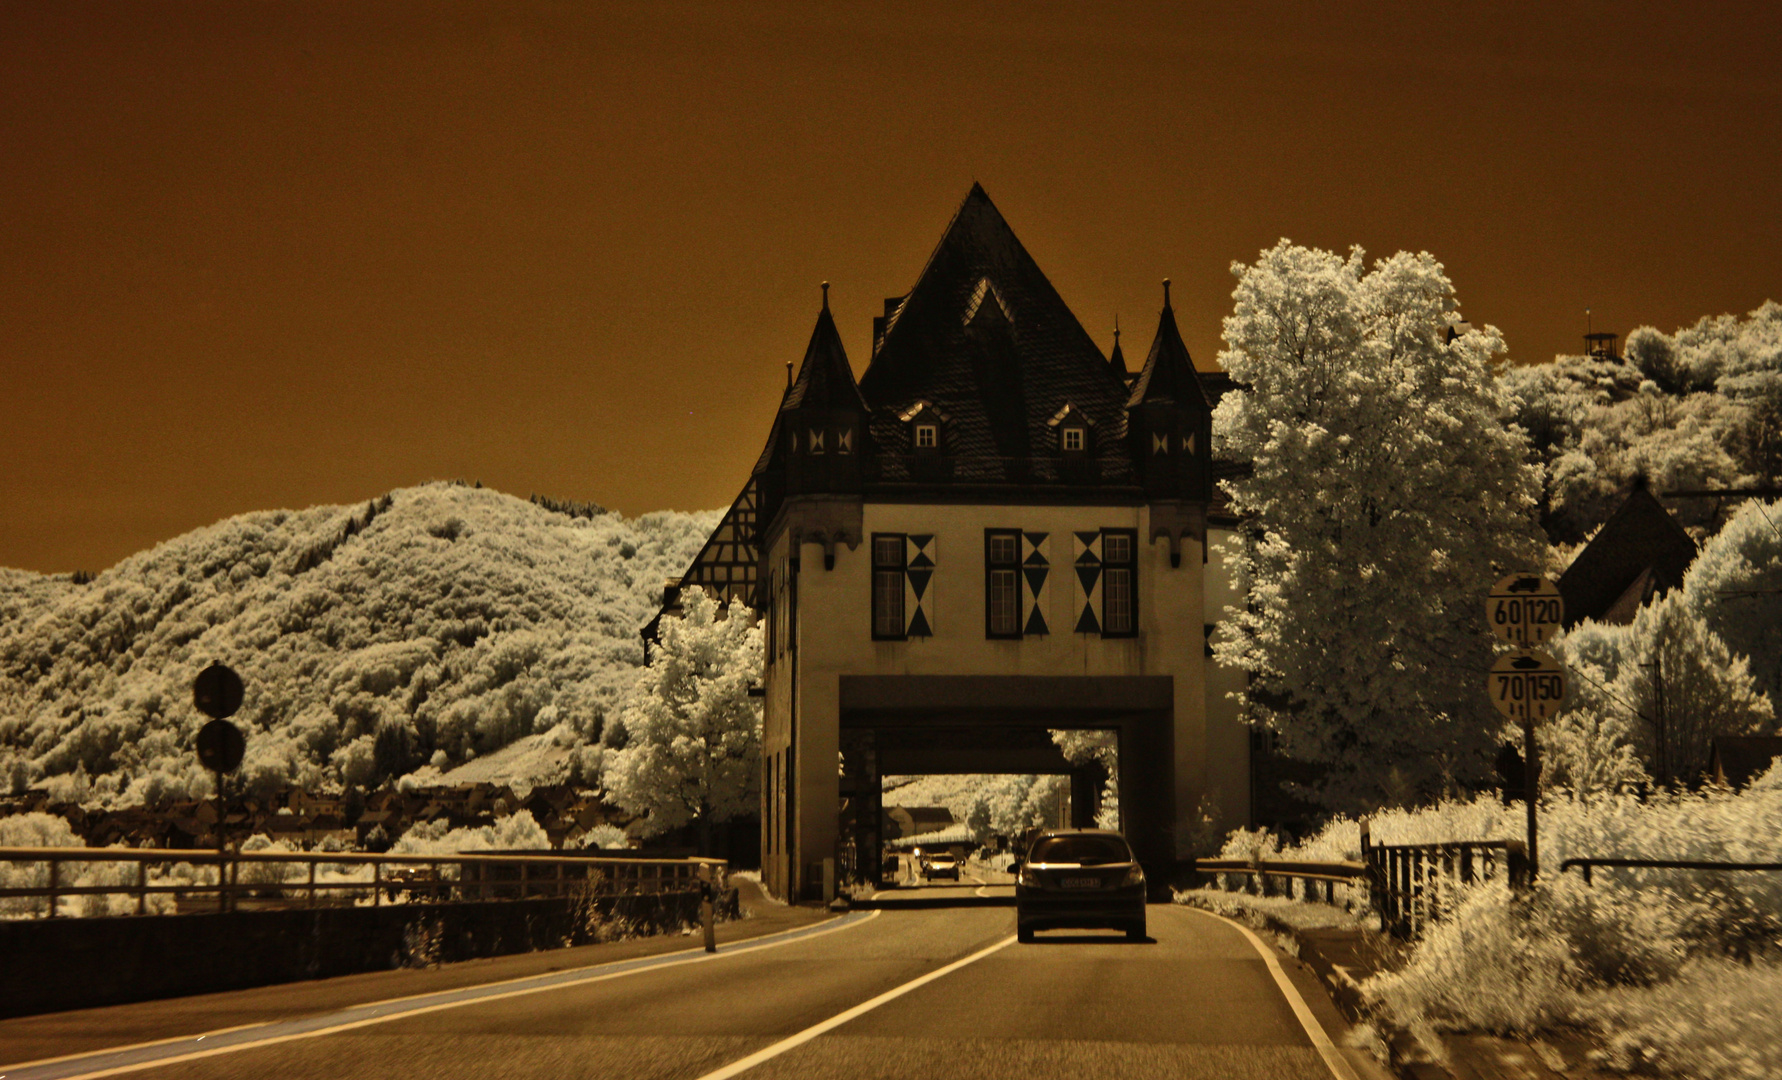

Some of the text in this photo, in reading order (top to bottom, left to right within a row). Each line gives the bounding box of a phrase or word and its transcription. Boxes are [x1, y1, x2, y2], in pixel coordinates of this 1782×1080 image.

[1494, 600, 1521, 625] 60
[1526, 600, 1560, 624] 120
[1498, 676, 1523, 701] 70
[1527, 675, 1563, 700] 150
